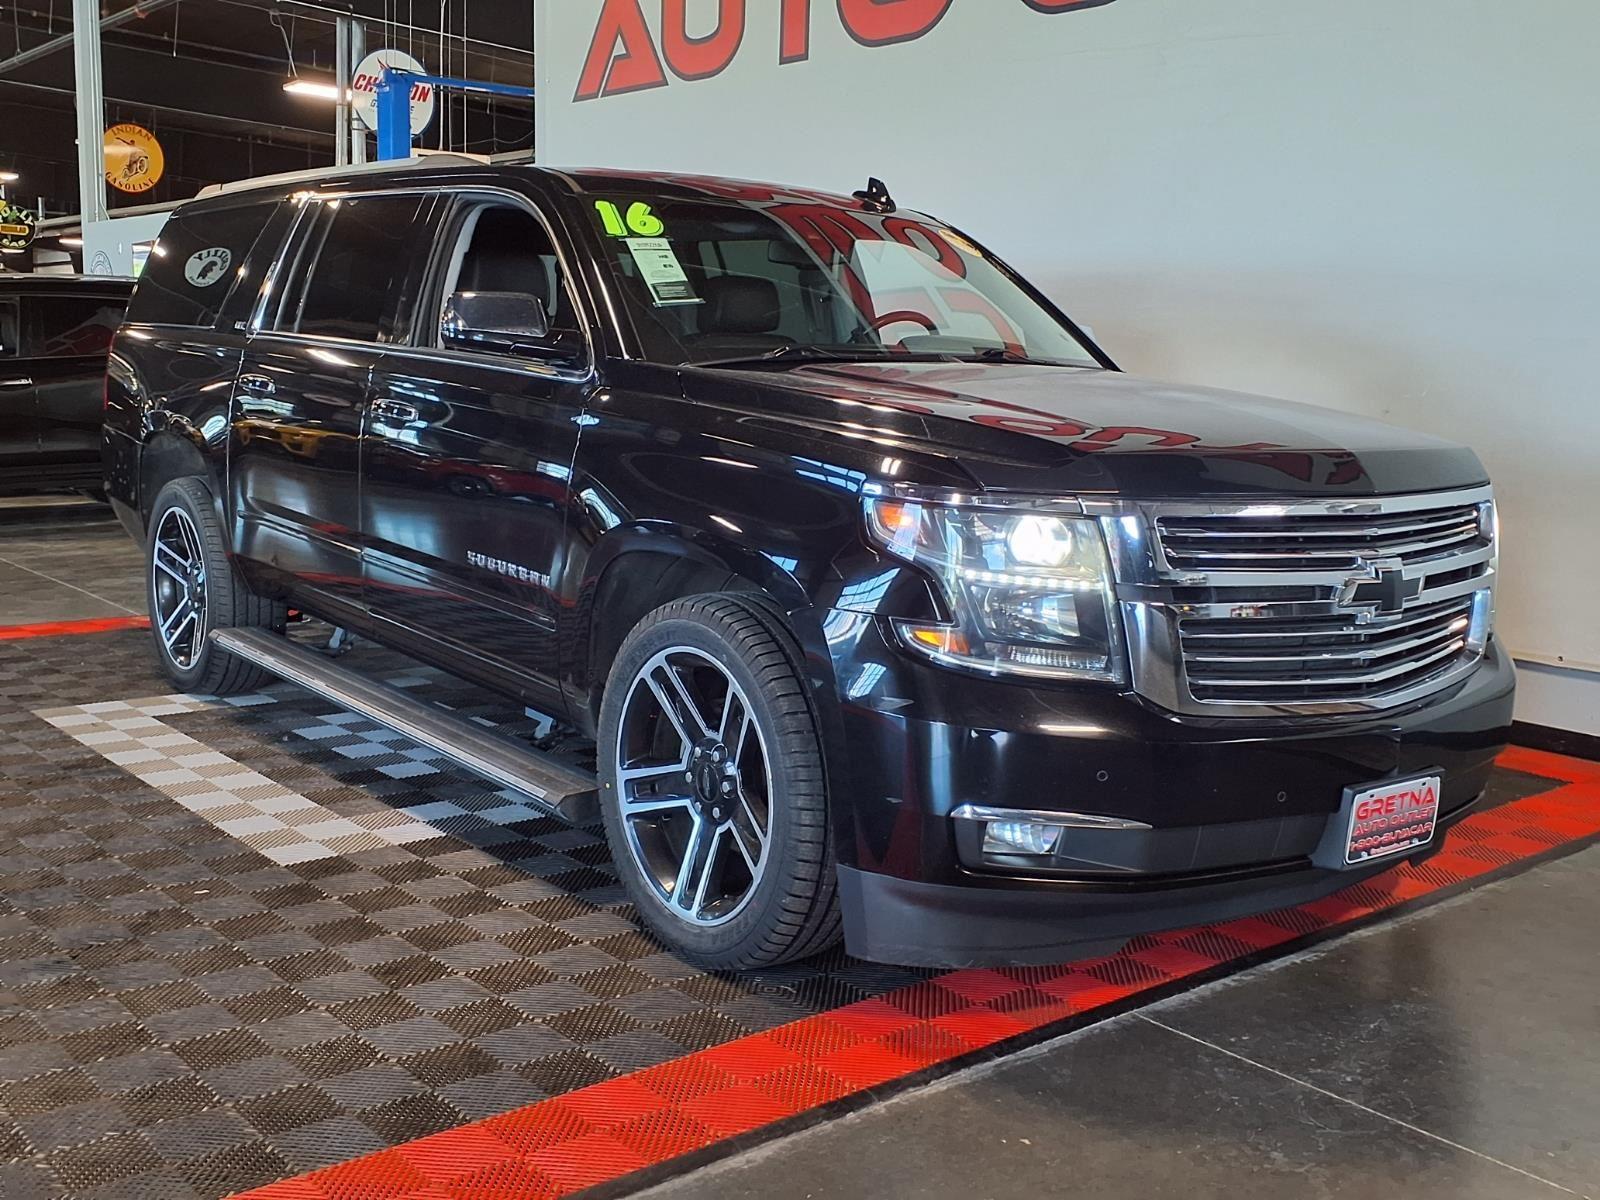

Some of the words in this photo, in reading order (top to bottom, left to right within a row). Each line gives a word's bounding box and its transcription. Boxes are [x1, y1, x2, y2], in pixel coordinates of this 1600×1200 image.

[353, 73, 431, 103] CHON
[111, 126, 153, 142] INDIAN
[105, 171, 155, 191] GASOLINE
[0, 206, 34, 226] OLY
[594, 200, 665, 237] 16
[467, 550, 551, 588] SUBURBAN
[1357, 787, 1435, 820] GRETNA
[1353, 818, 1388, 836] AUTO
[1391, 807, 1435, 825] OUTLET
